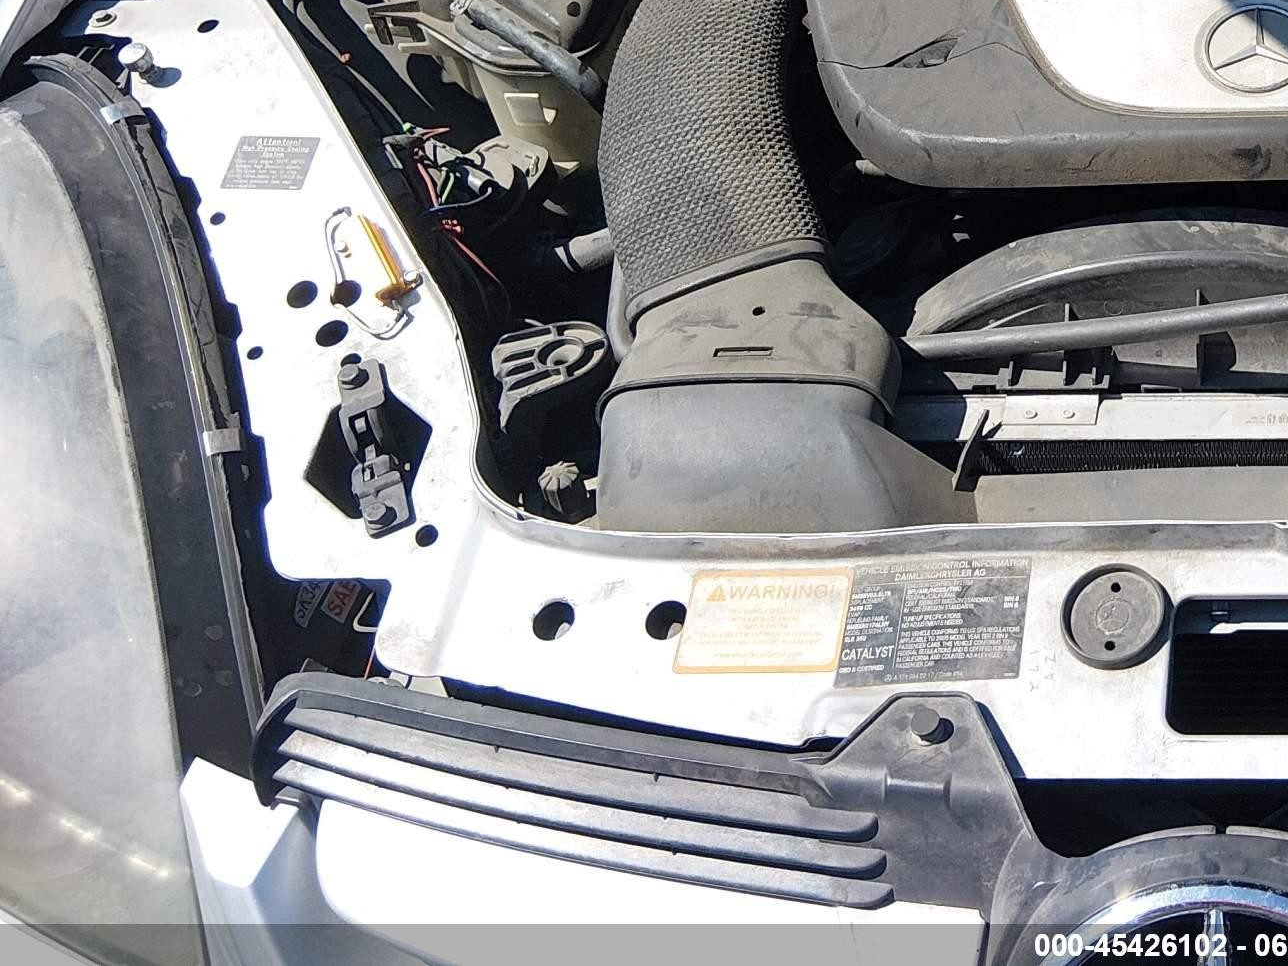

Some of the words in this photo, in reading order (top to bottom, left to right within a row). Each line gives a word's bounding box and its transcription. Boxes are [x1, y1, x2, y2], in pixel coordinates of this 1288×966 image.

[974, 569, 986, 577] AG
[729, 584, 834, 599] WARNING!
[842, 646, 894, 660] CATALYST
